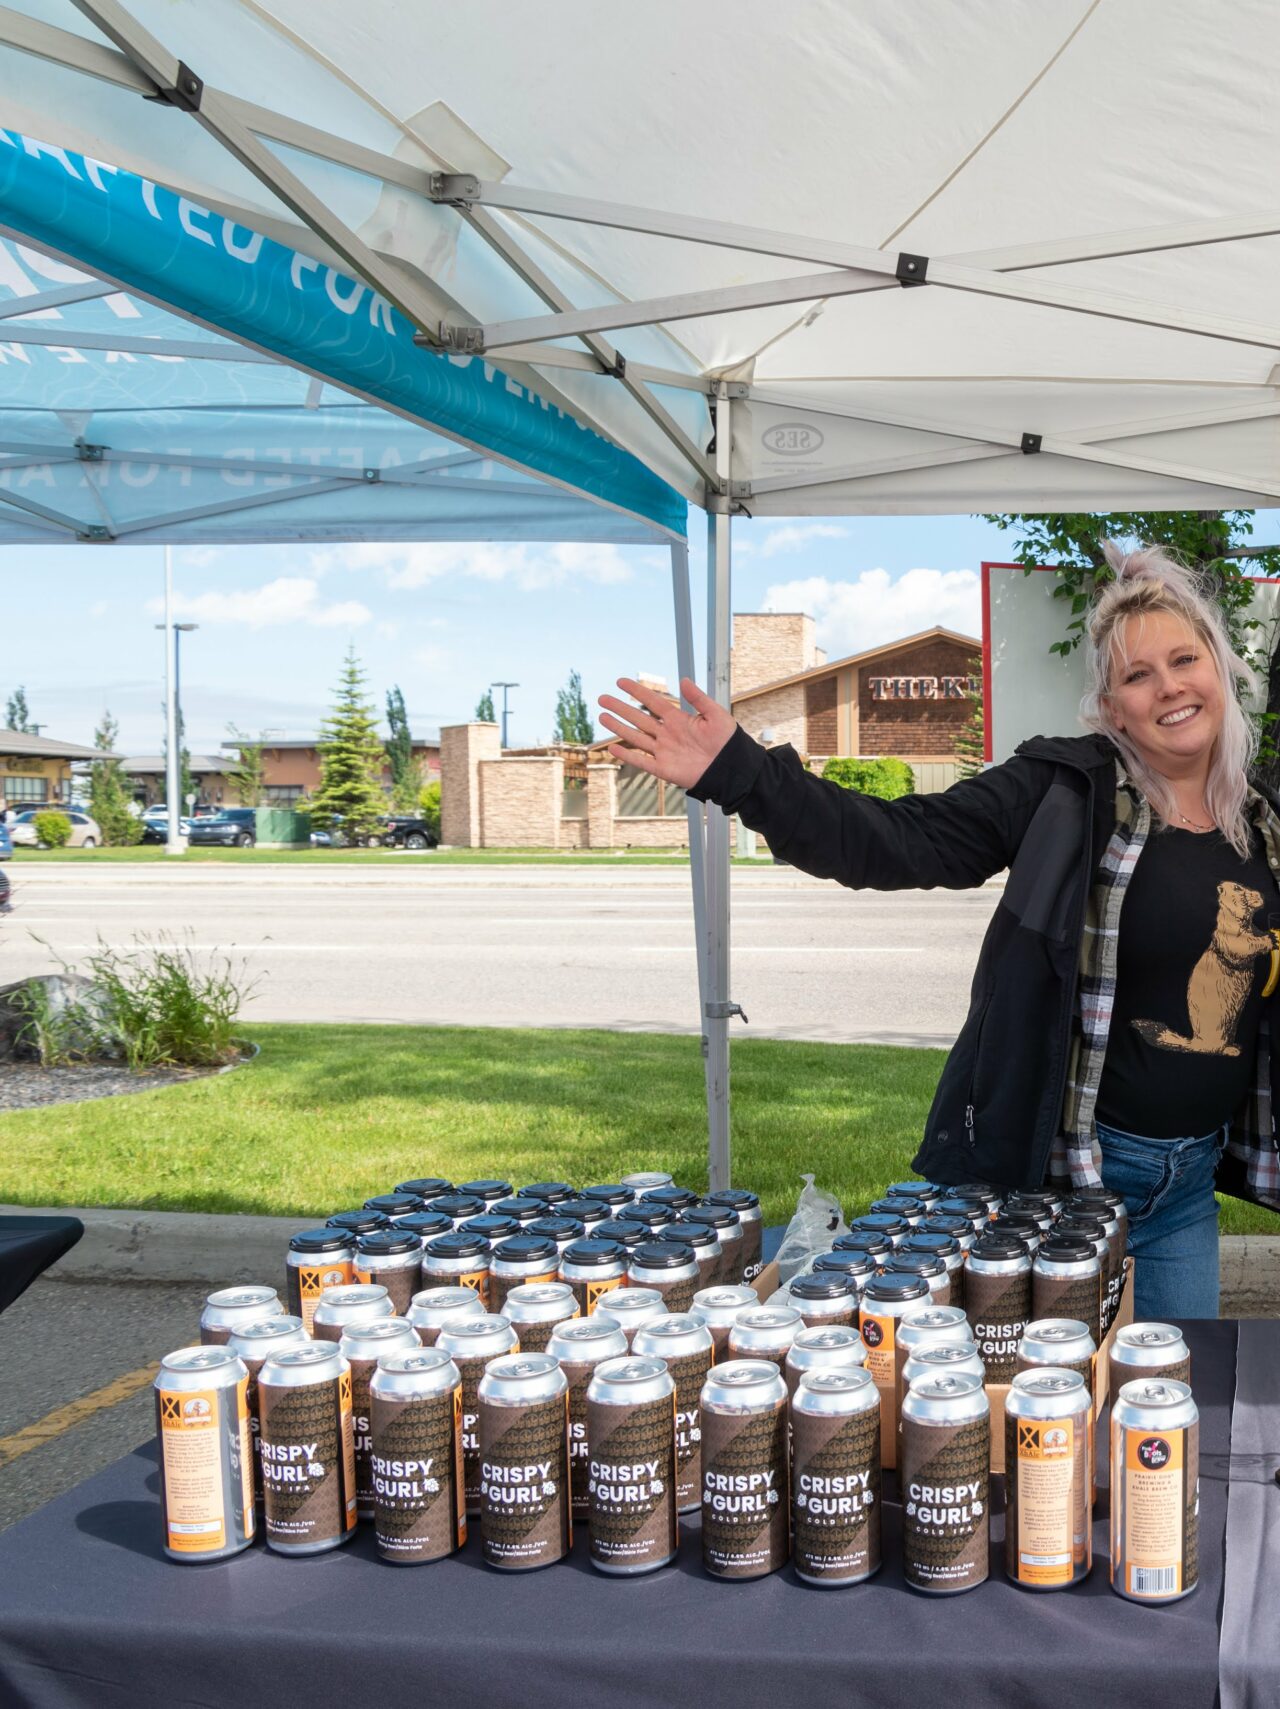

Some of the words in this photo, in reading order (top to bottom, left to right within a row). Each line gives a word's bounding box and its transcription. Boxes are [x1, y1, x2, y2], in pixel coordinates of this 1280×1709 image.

[869, 677, 938, 700] THE
[982, 1340, 1021, 1355] GUR
[263, 1461, 308, 1481] GURL
[370, 1454, 434, 1477] CRISPY
[482, 1461, 552, 1483] CRISPY
[590, 1460, 659, 1482] CRISPY
[376, 1477, 423, 1498] GURL
[705, 1470, 775, 1492] CRISPY
[800, 1470, 870, 1494] CRISPY
[489, 1483, 542, 1504] GURL
[597, 1484, 650, 1503] GURL
[909, 1480, 980, 1504] CRISPY
[404, 1500, 425, 1508] IPA
[488, 1504, 514, 1514] COLD
[523, 1504, 544, 1514] IPA
[597, 1503, 622, 1513] COLD
[631, 1503, 651, 1512] IPA
[712, 1494, 766, 1513] GURL
[808, 1495, 862, 1515] GURL
[711, 1513, 738, 1523] COLD
[747, 1513, 768, 1523] IPA
[807, 1516, 836, 1525] COLD
[844, 1514, 864, 1524] IPA
[917, 1505, 971, 1525] GURL
[916, 1526, 944, 1535] COLD
[953, 1525, 973, 1535] IPA
